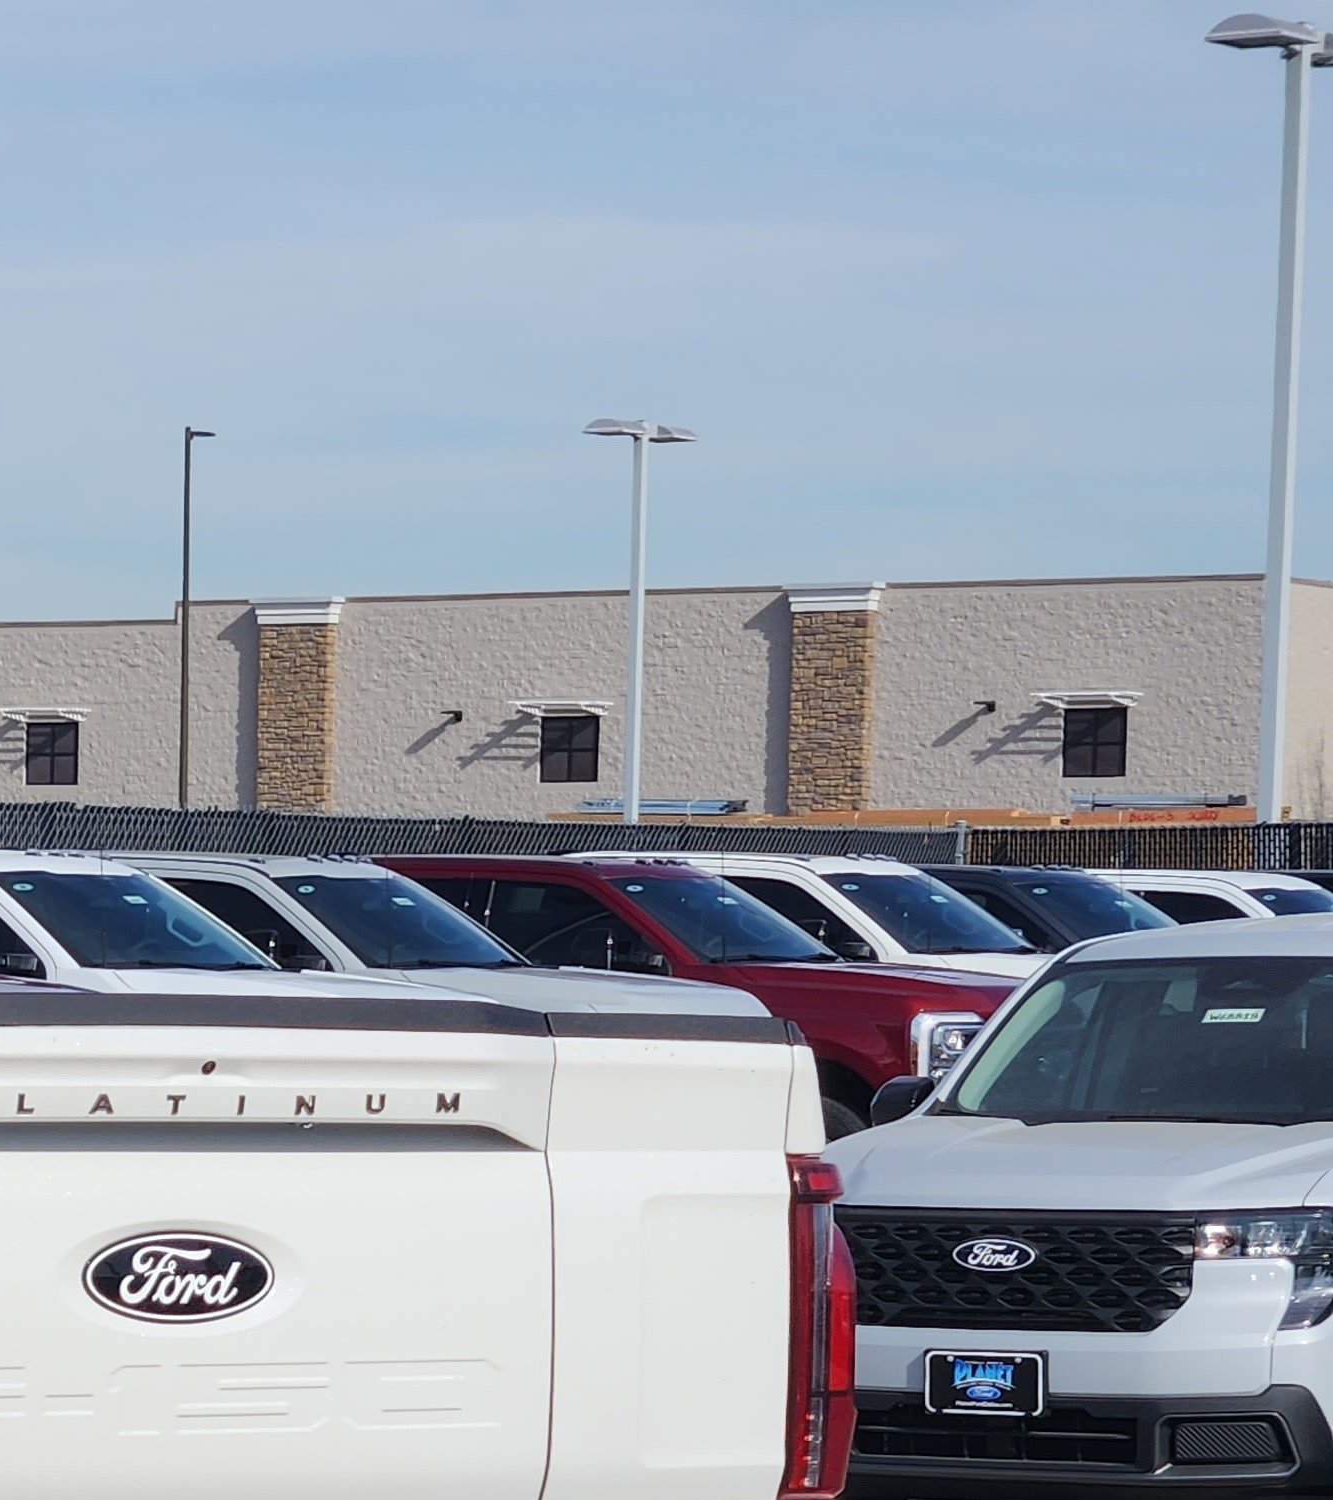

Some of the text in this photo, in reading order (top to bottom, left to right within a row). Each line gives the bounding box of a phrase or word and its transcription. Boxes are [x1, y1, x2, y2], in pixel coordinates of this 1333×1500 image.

[967, 1243, 1019, 1268] Ford
[118, 1244, 241, 1308] Ford
[954, 1359, 1015, 1384] PLANET
